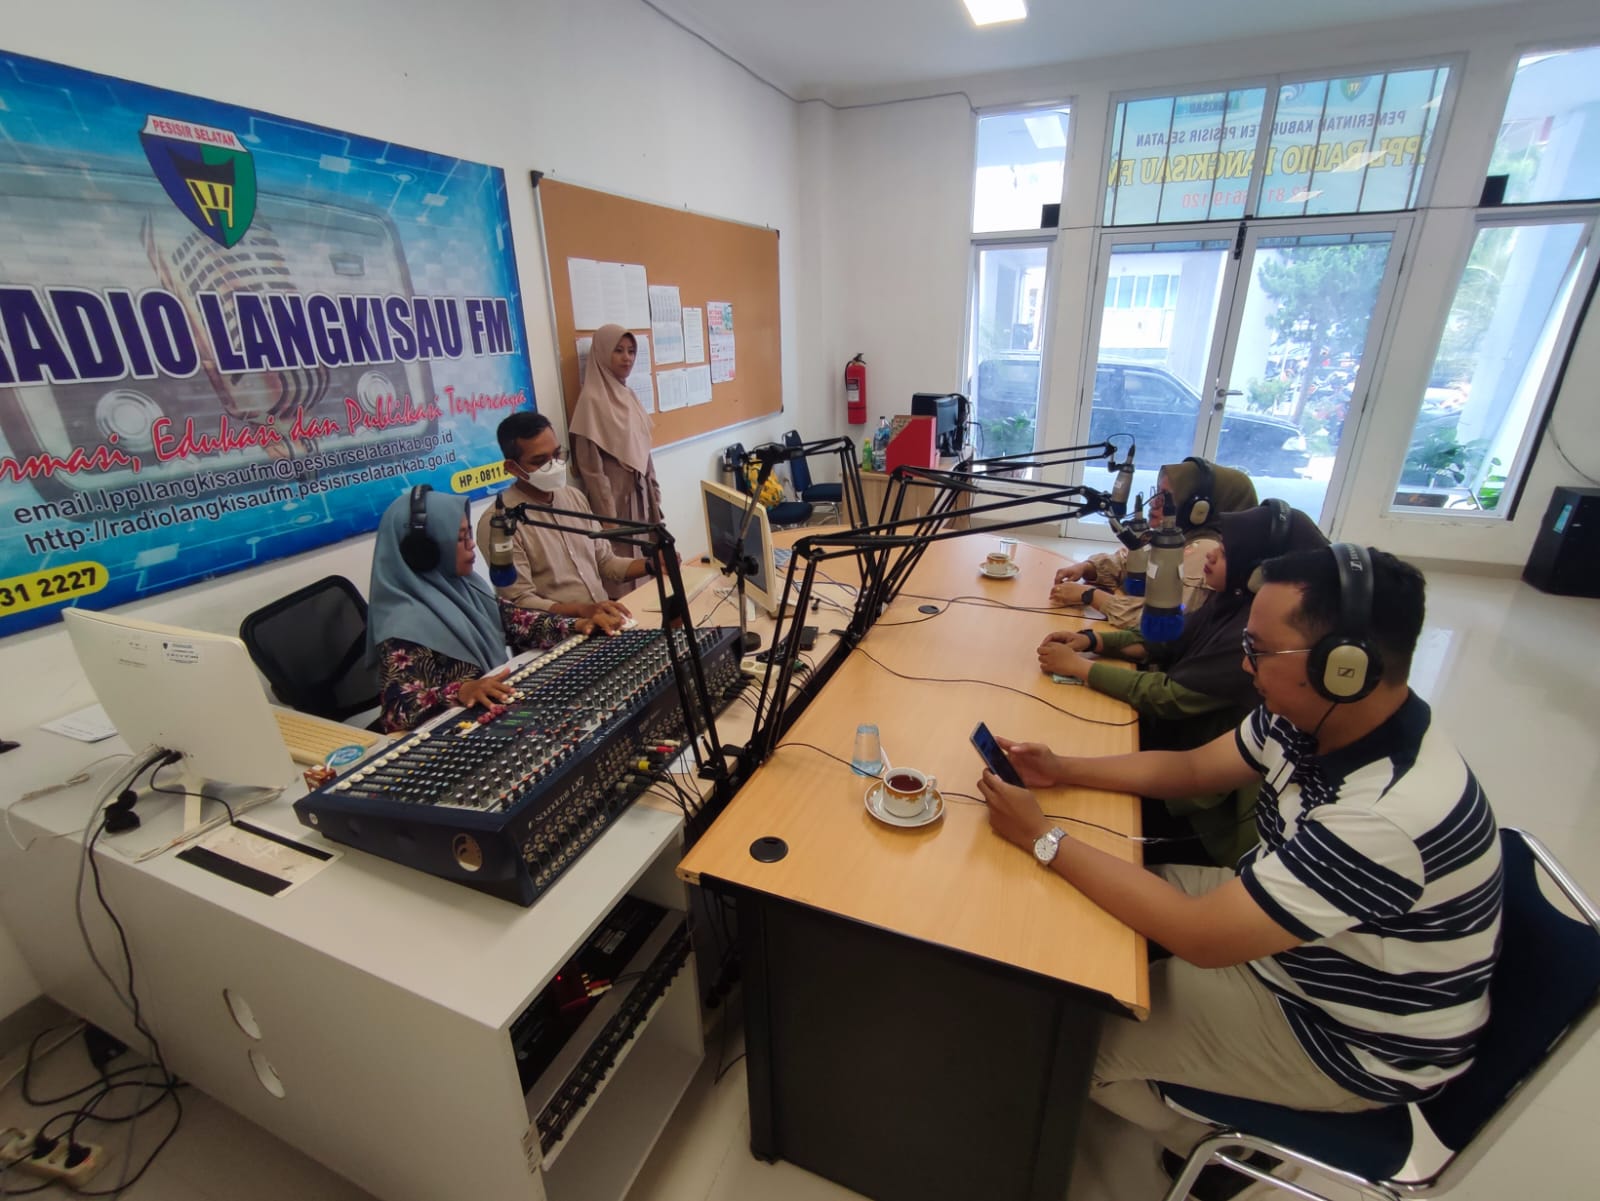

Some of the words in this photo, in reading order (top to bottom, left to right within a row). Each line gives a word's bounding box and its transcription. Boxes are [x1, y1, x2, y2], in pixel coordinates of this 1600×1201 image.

[152, 119, 193, 137] PESISIR
[194, 127, 236, 146] SELATAN
[0, 286, 199, 385] ADIO
[198, 291, 463, 373] LANGKISAU
[465, 297, 513, 356] FM
[152, 415, 281, 462] Edukasi
[290, 405, 342, 440] dan
[344, 392, 443, 436] Publikasi
[444, 385, 527, 423] Terpercaya
[25, 449, 456, 554] http://radiolangkisaufm.pesisirselatankab.go.id
[459, 474, 472, 488] HP
[480, 466, 501, 482] 0811
[37, 567, 96, 598] 2227
